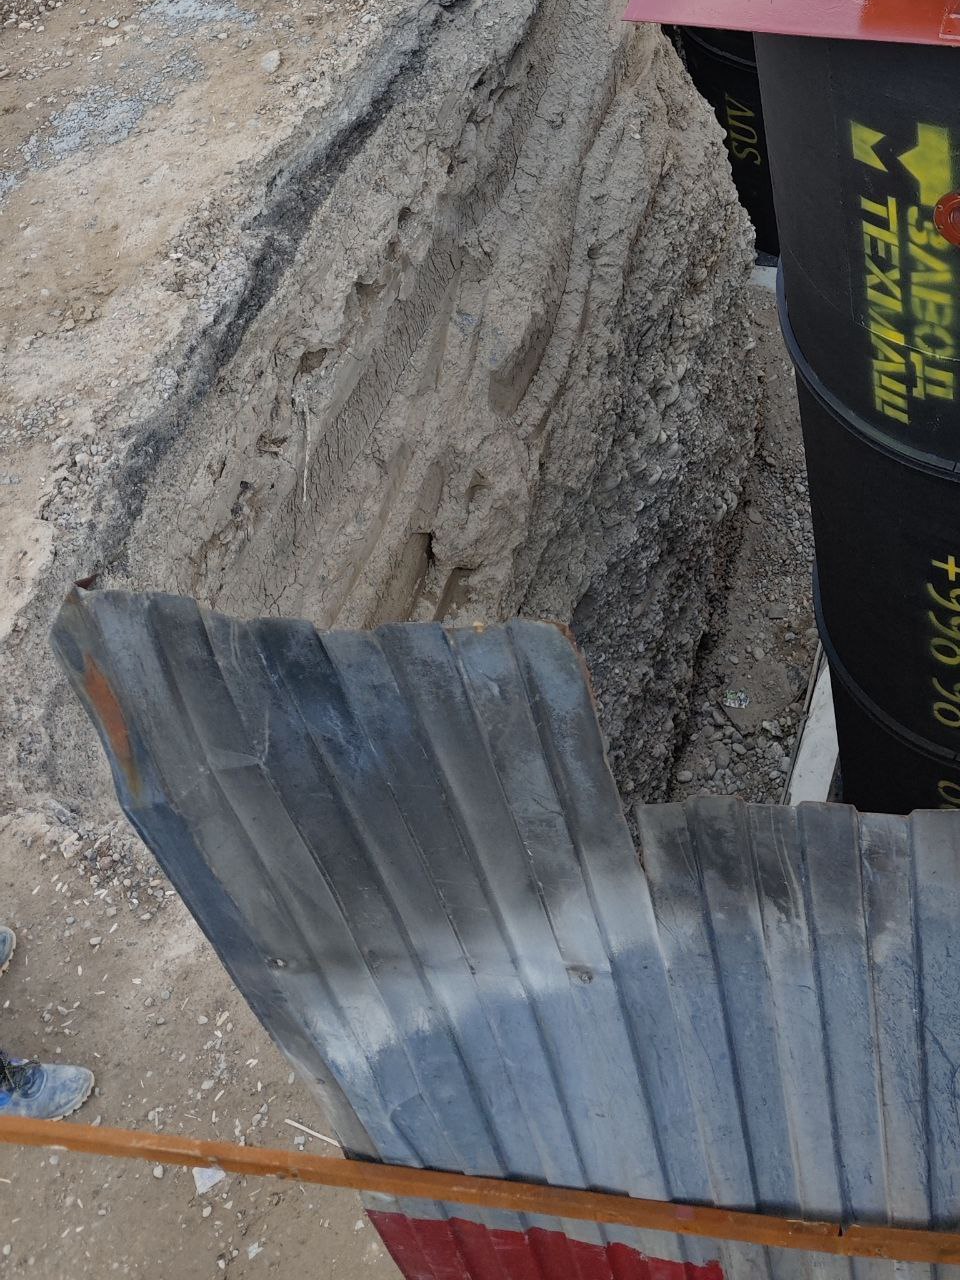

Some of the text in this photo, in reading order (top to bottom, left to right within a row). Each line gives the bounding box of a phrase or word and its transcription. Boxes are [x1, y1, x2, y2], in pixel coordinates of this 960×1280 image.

[725, 92, 761, 165] SUV
[860, 195, 911, 425] ТЕХМАШ
[907, 205, 955, 401] ЗАВОД
